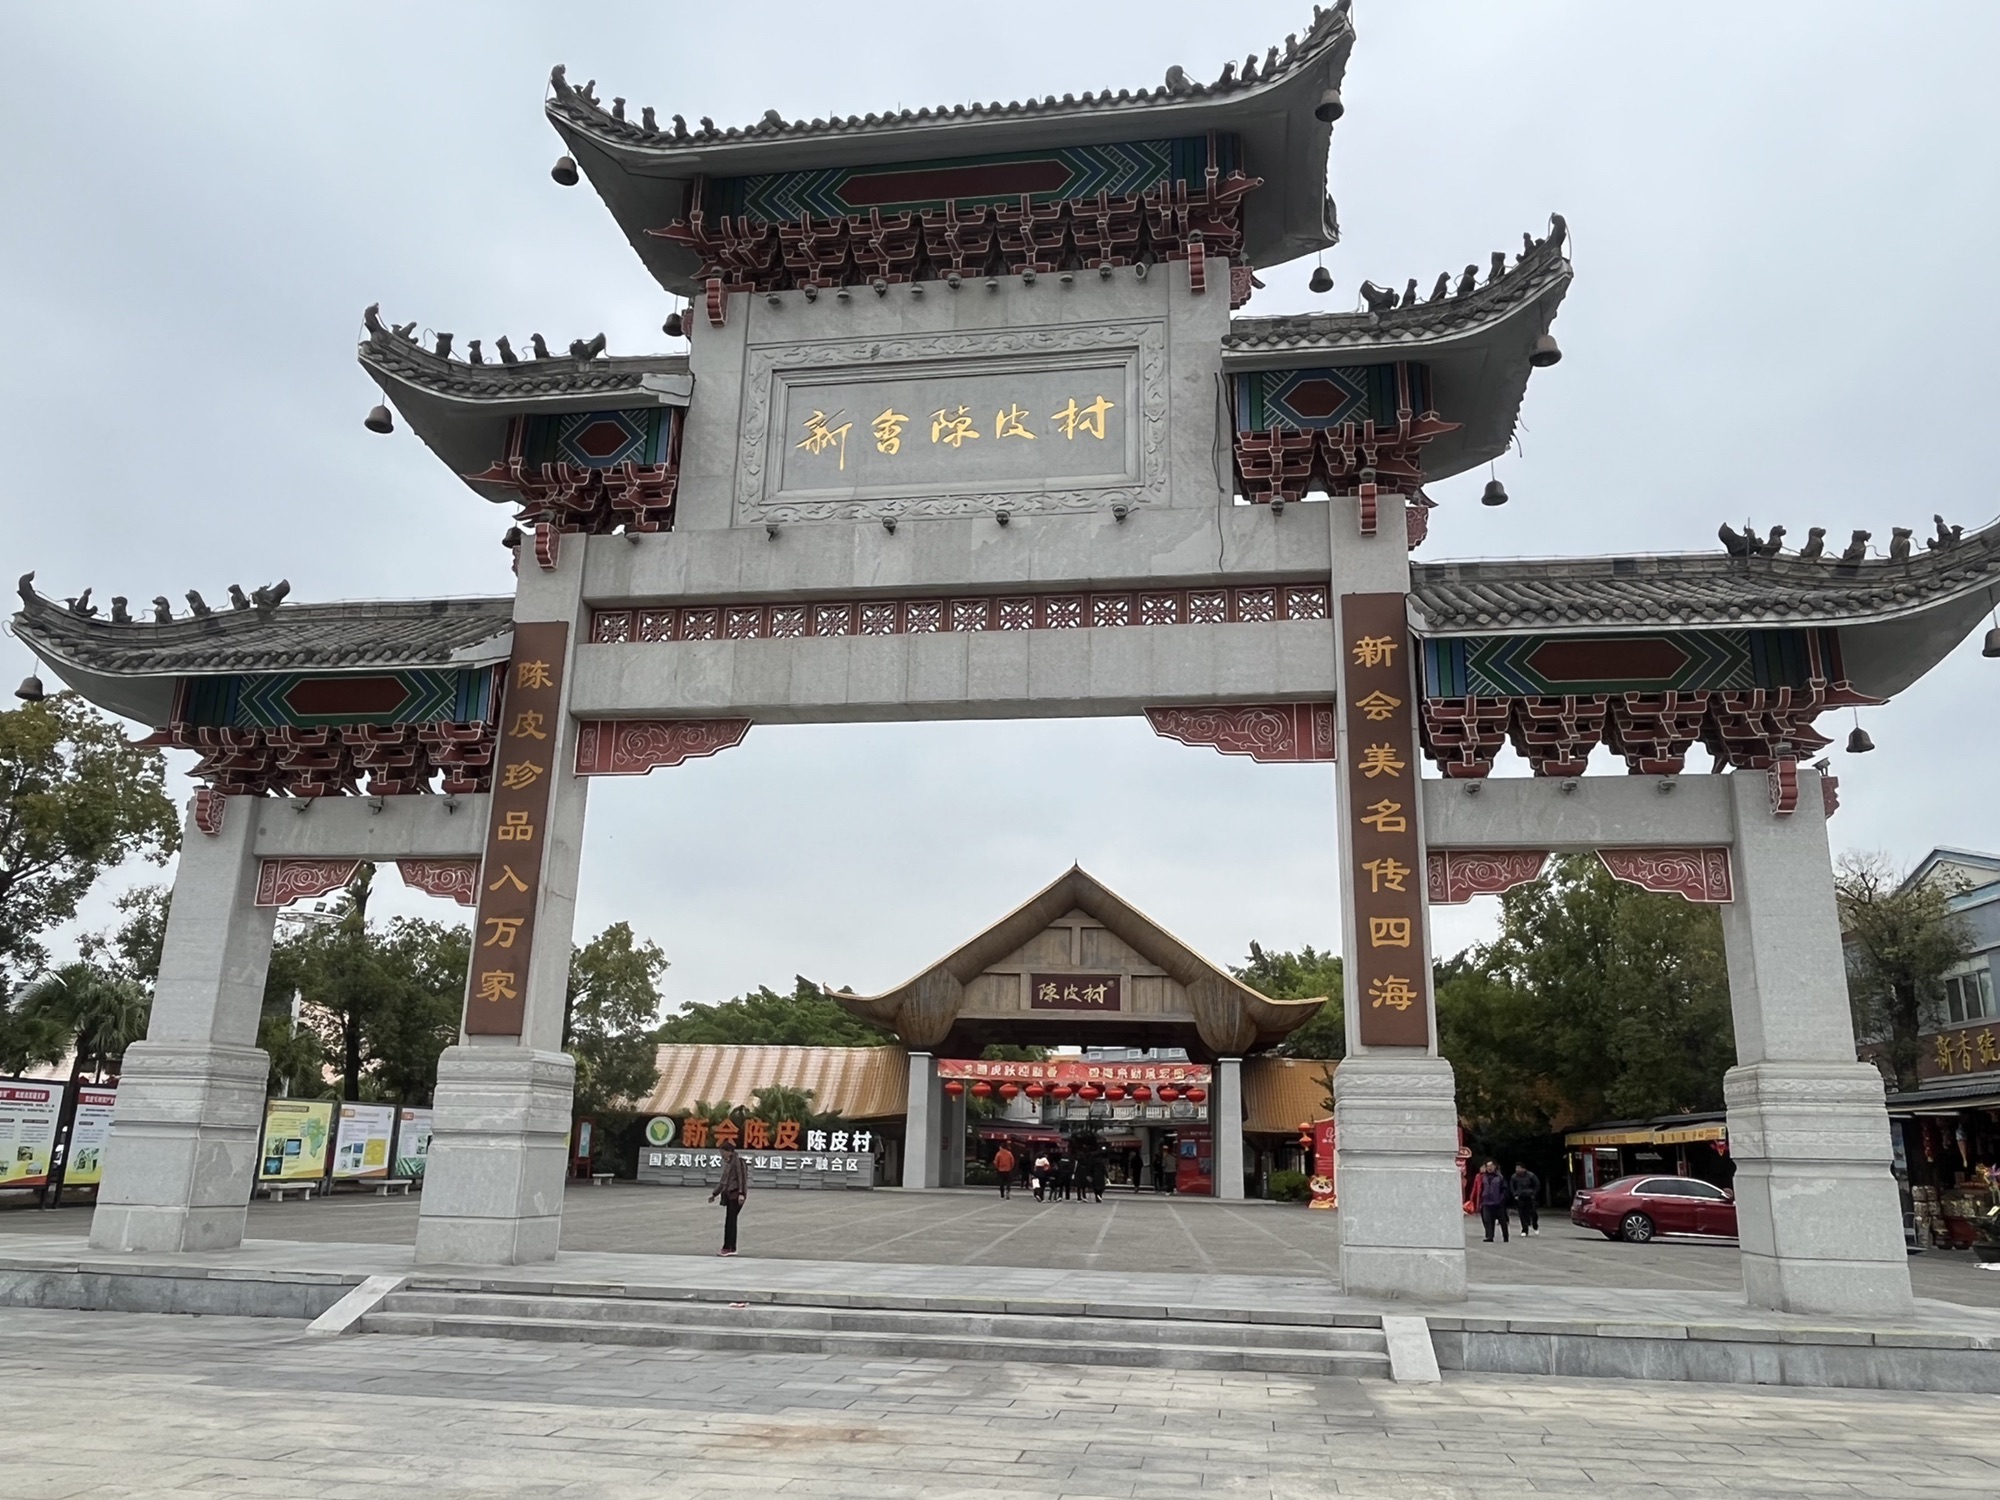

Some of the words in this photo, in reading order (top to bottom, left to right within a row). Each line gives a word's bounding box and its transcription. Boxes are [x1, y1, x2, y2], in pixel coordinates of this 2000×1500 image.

[476, 660, 554, 1003] 陈皮珍品入万家
[1352, 635, 1418, 1012] 新会美名传四海
[648, 1153, 860, 1172] 国家现代农产业园三产融合区
[681, 1117, 802, 1149] 新会陈皮
[806, 1129, 873, 1153] 陈皮村
